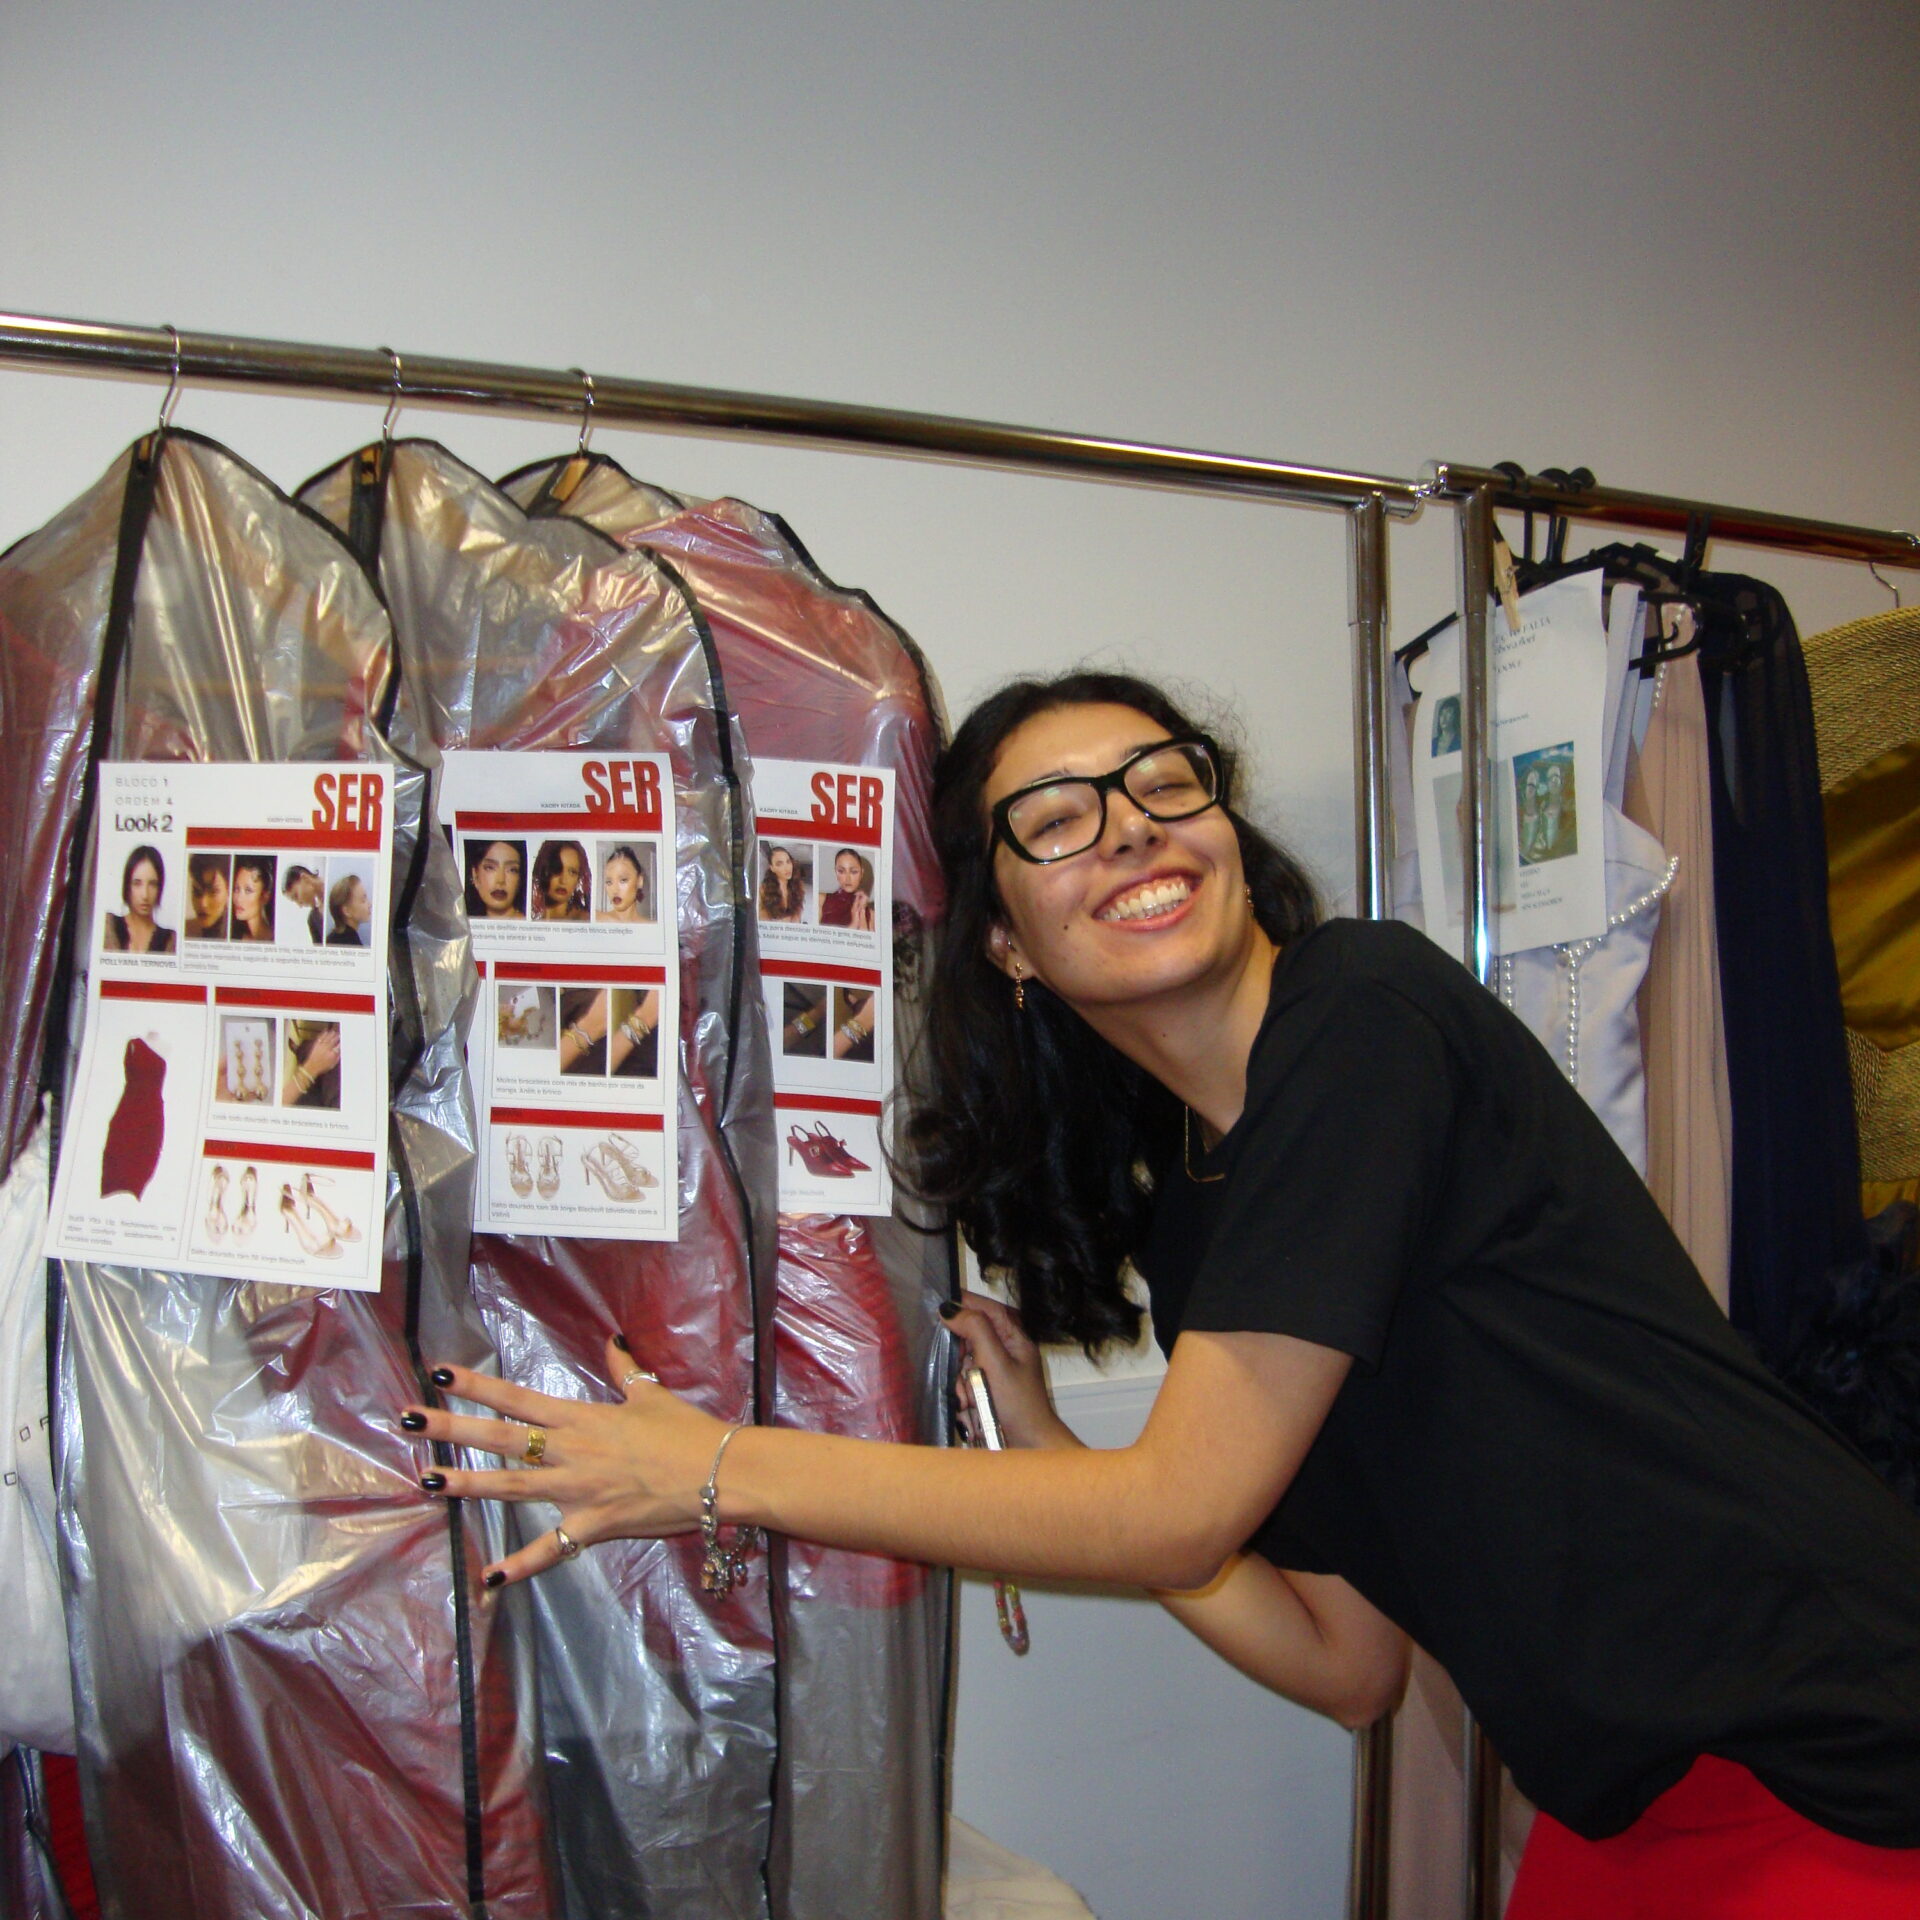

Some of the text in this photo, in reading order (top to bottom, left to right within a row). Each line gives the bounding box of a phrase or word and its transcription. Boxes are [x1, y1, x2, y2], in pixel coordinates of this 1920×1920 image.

[115, 777, 168, 788] BLOCO 1
[582, 760, 662, 814] SER
[115, 796, 173, 807] ORDEM 4
[312, 773, 384, 831] SER
[811, 772, 884, 829] SER
[115, 812, 173, 832] Look 2
[99, 957, 139, 967] POLLYANA
